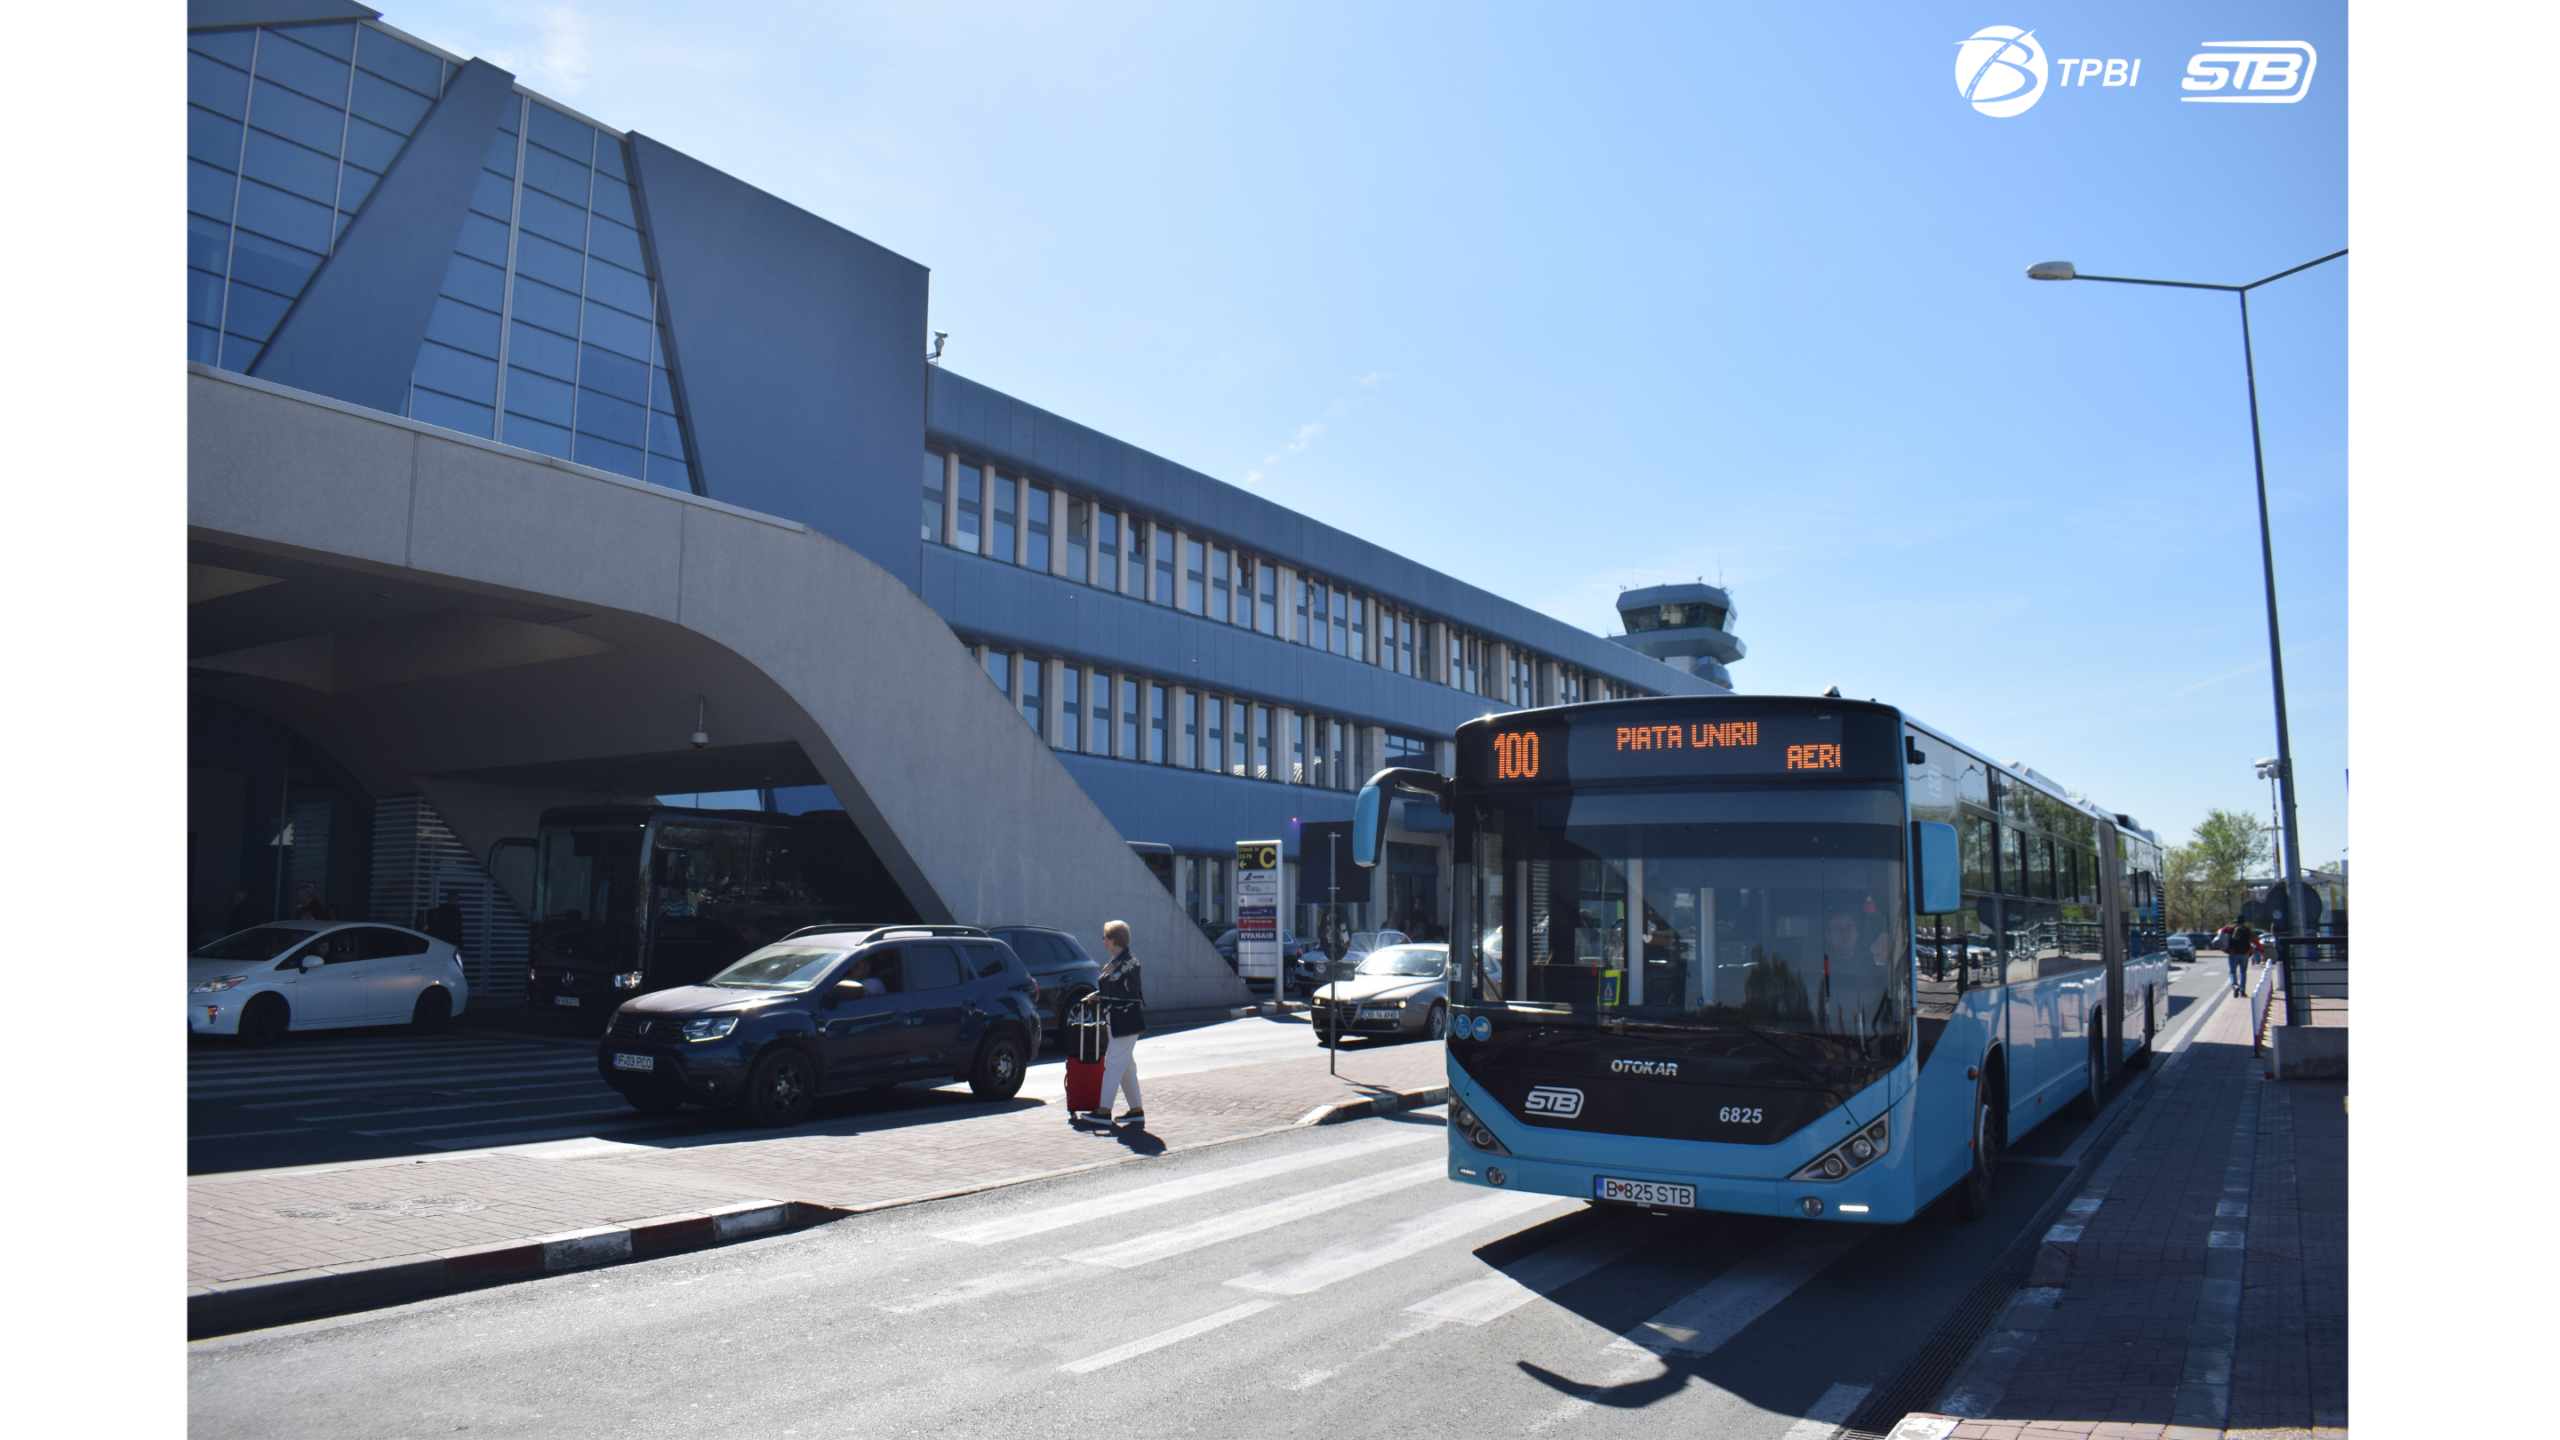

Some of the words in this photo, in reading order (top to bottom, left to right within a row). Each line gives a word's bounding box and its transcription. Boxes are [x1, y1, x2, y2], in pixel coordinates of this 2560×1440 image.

[1617, 724, 1682, 751] PIATA
[1691, 721, 1758, 748] UNIRII
[1493, 731, 1539, 779] 100
[1259, 847, 1276, 869] C
[1610, 1059, 1678, 1077] OTOKAR
[1525, 1090, 1578, 1112] STB
[1719, 1106, 1763, 1124] 6825
[1606, 1180, 1618, 1197] B
[1624, 1182, 1653, 1201] 825
[1656, 1186, 1691, 1205] STB
